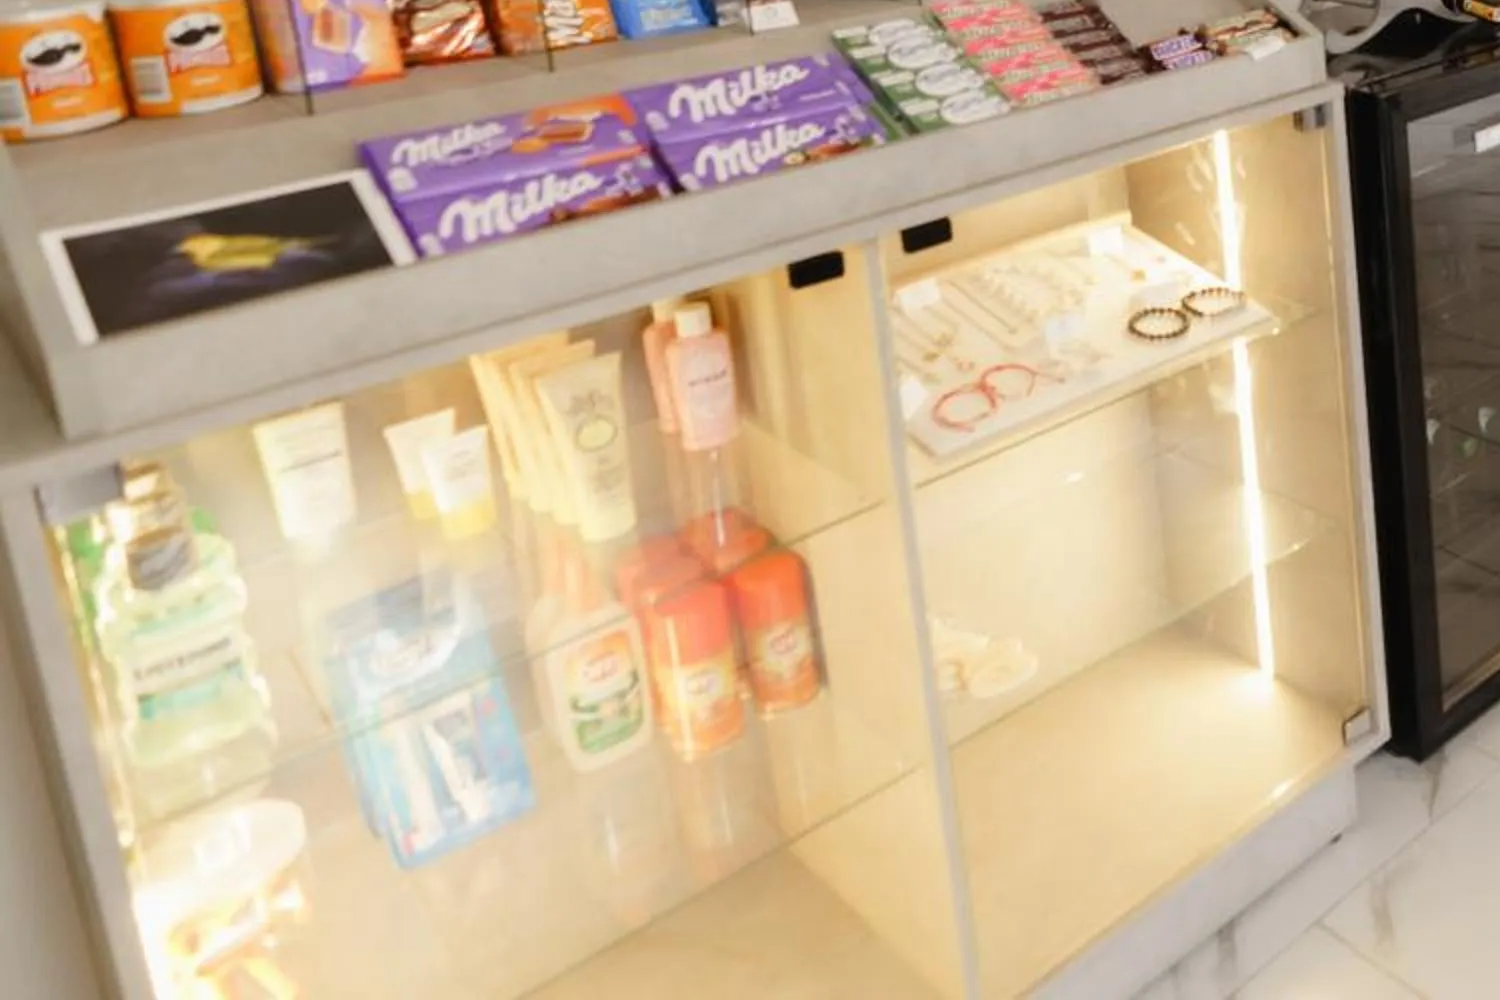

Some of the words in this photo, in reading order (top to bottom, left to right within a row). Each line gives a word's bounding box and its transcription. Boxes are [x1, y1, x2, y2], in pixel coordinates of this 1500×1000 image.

[669, 63, 811, 123] Milka
[391, 122, 507, 167] Milka
[695, 123, 827, 183] Milka
[439, 171, 605, 243] Milka
